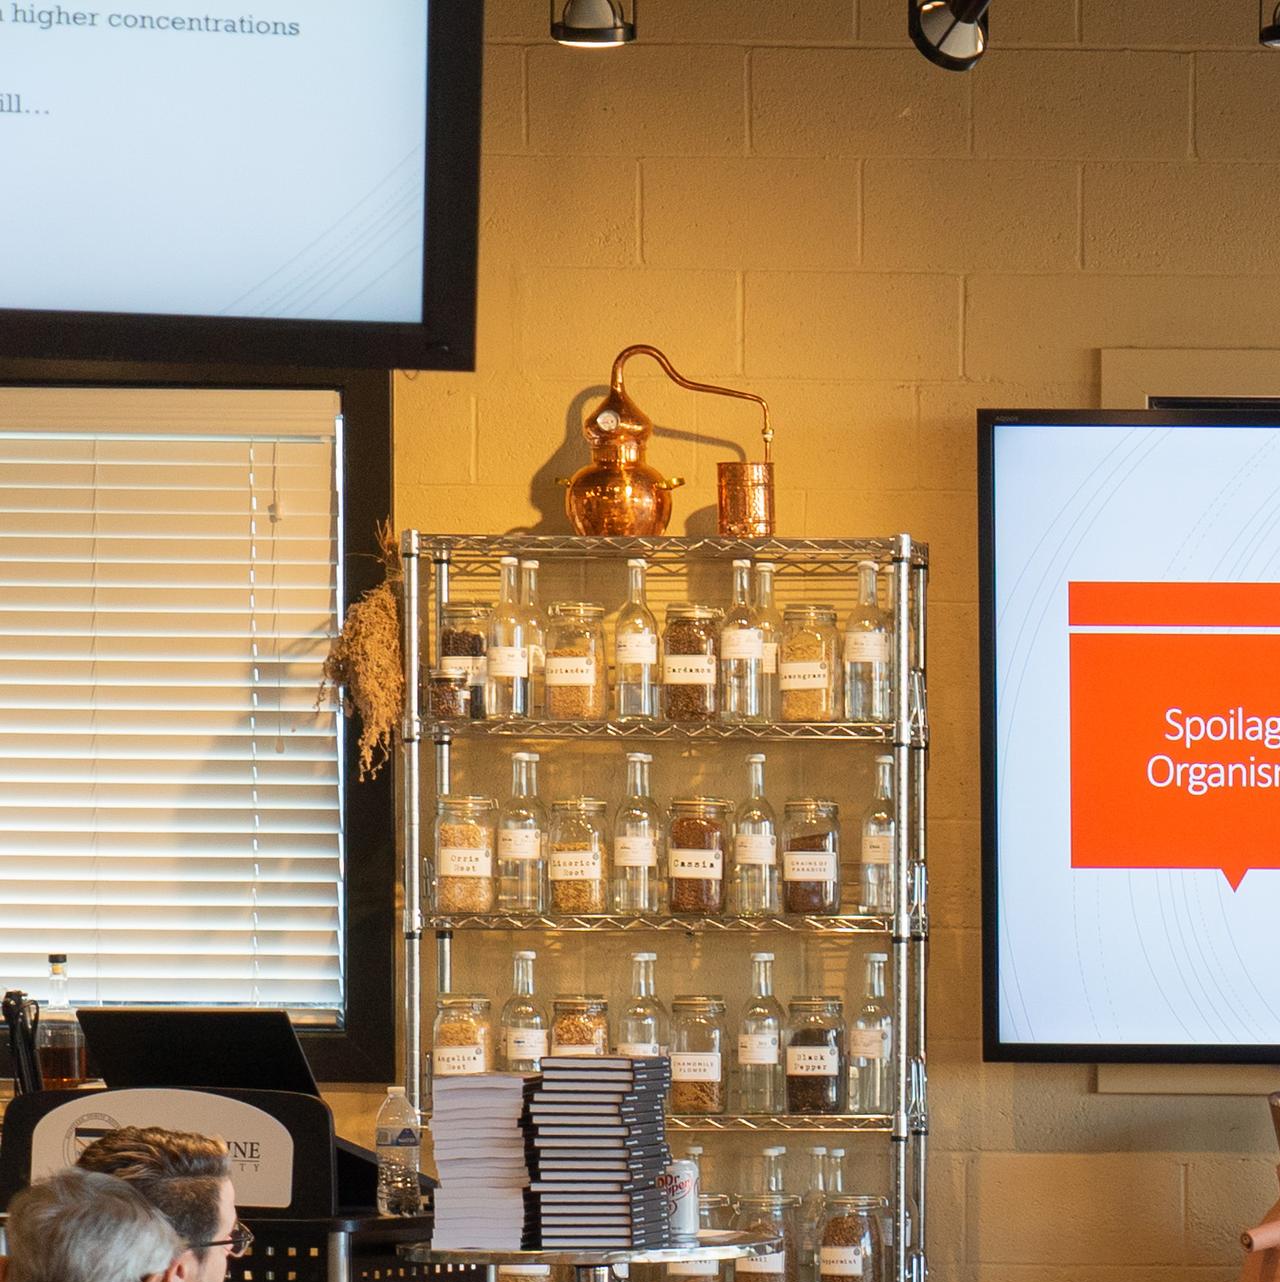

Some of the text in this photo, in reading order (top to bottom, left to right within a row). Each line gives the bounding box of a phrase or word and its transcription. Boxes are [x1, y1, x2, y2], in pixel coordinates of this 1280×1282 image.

[11, 2, 302, 37] higher concentrations
[672, 859, 715, 869] Cassia
